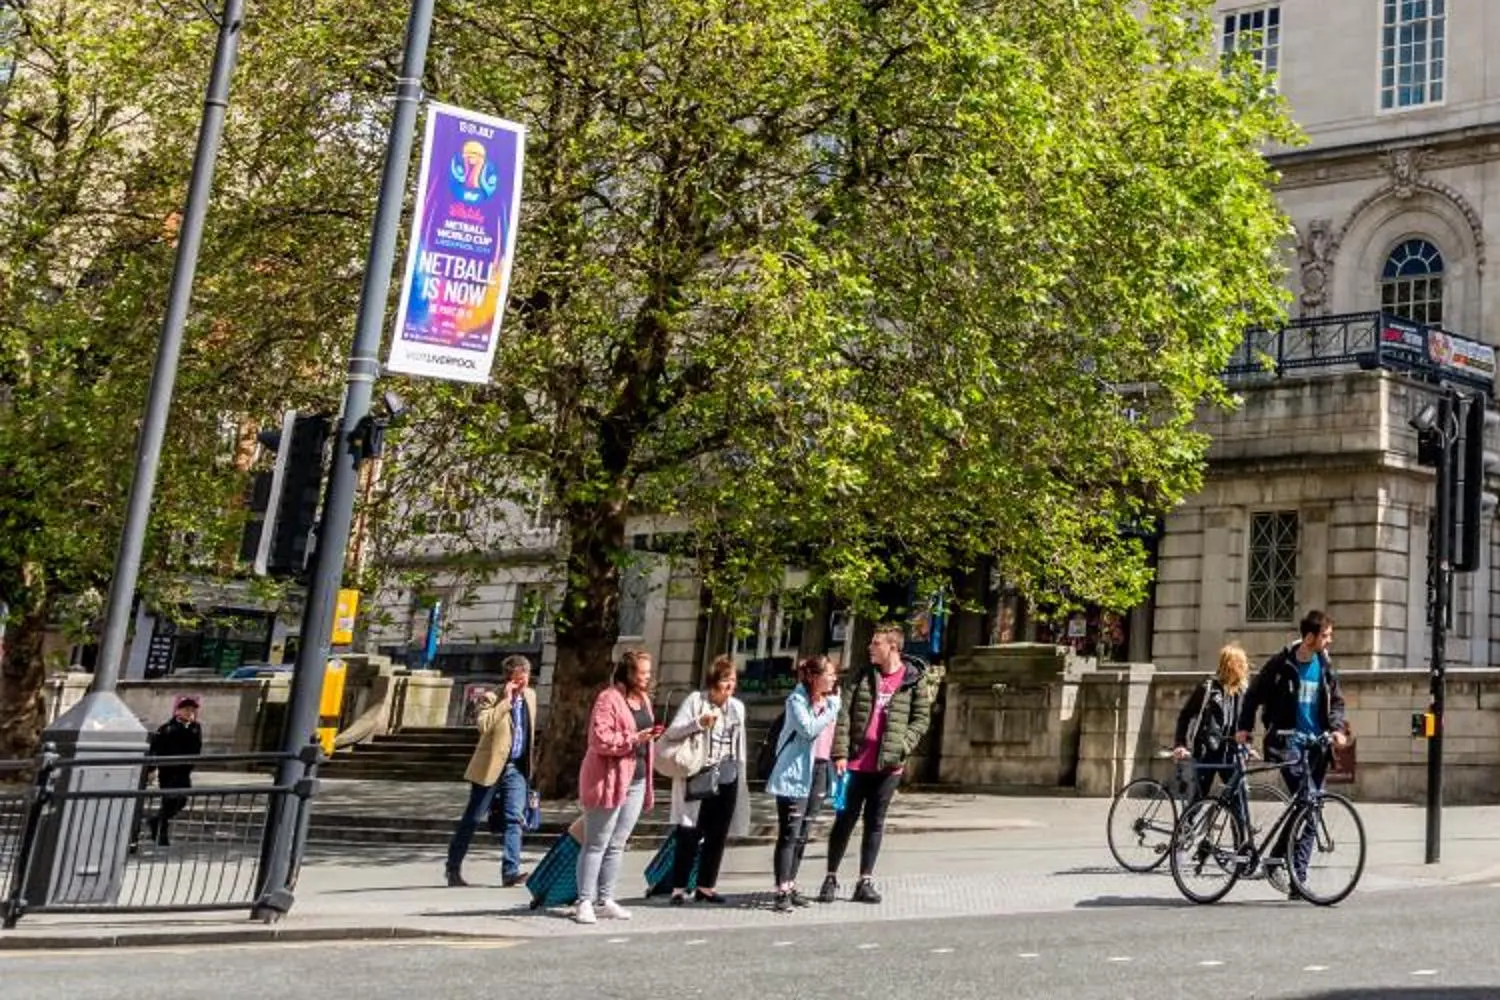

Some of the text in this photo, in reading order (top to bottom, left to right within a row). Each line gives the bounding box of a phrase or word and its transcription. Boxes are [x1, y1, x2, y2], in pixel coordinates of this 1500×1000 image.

[436, 228, 493, 246] WORLD CUP
[445, 220, 484, 234] NETBALL
[419, 251, 496, 285] NETBALL
[422, 277, 487, 308] IS NOW
